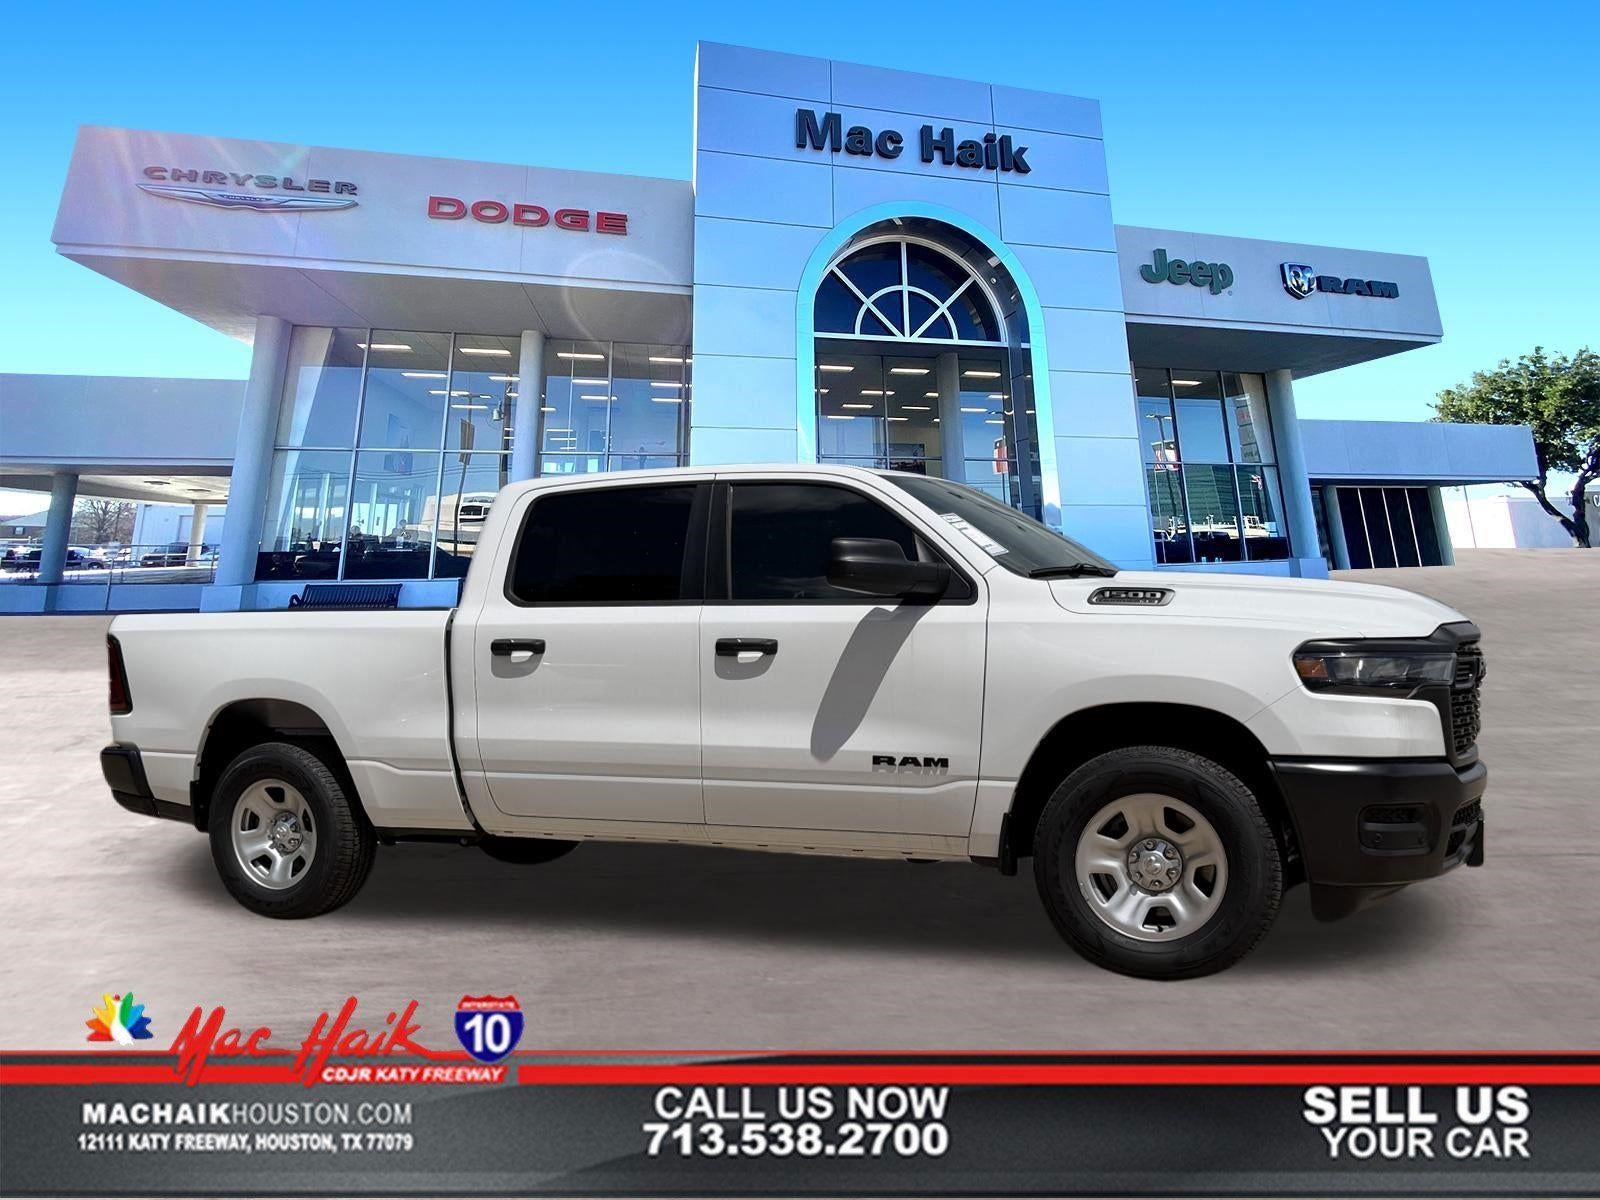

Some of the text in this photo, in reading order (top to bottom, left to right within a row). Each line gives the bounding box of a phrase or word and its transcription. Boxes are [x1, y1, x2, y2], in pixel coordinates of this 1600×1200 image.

[796, 108, 1032, 174] Mac Haik
[143, 166, 358, 196] CHRYSLER
[428, 196, 628, 236] DODGE
[1140, 248, 1234, 295] Jeep
[1316, 275, 1399, 298] RAM
[1104, 590, 1162, 599] 1500
[872, 755, 949, 768] RAM
